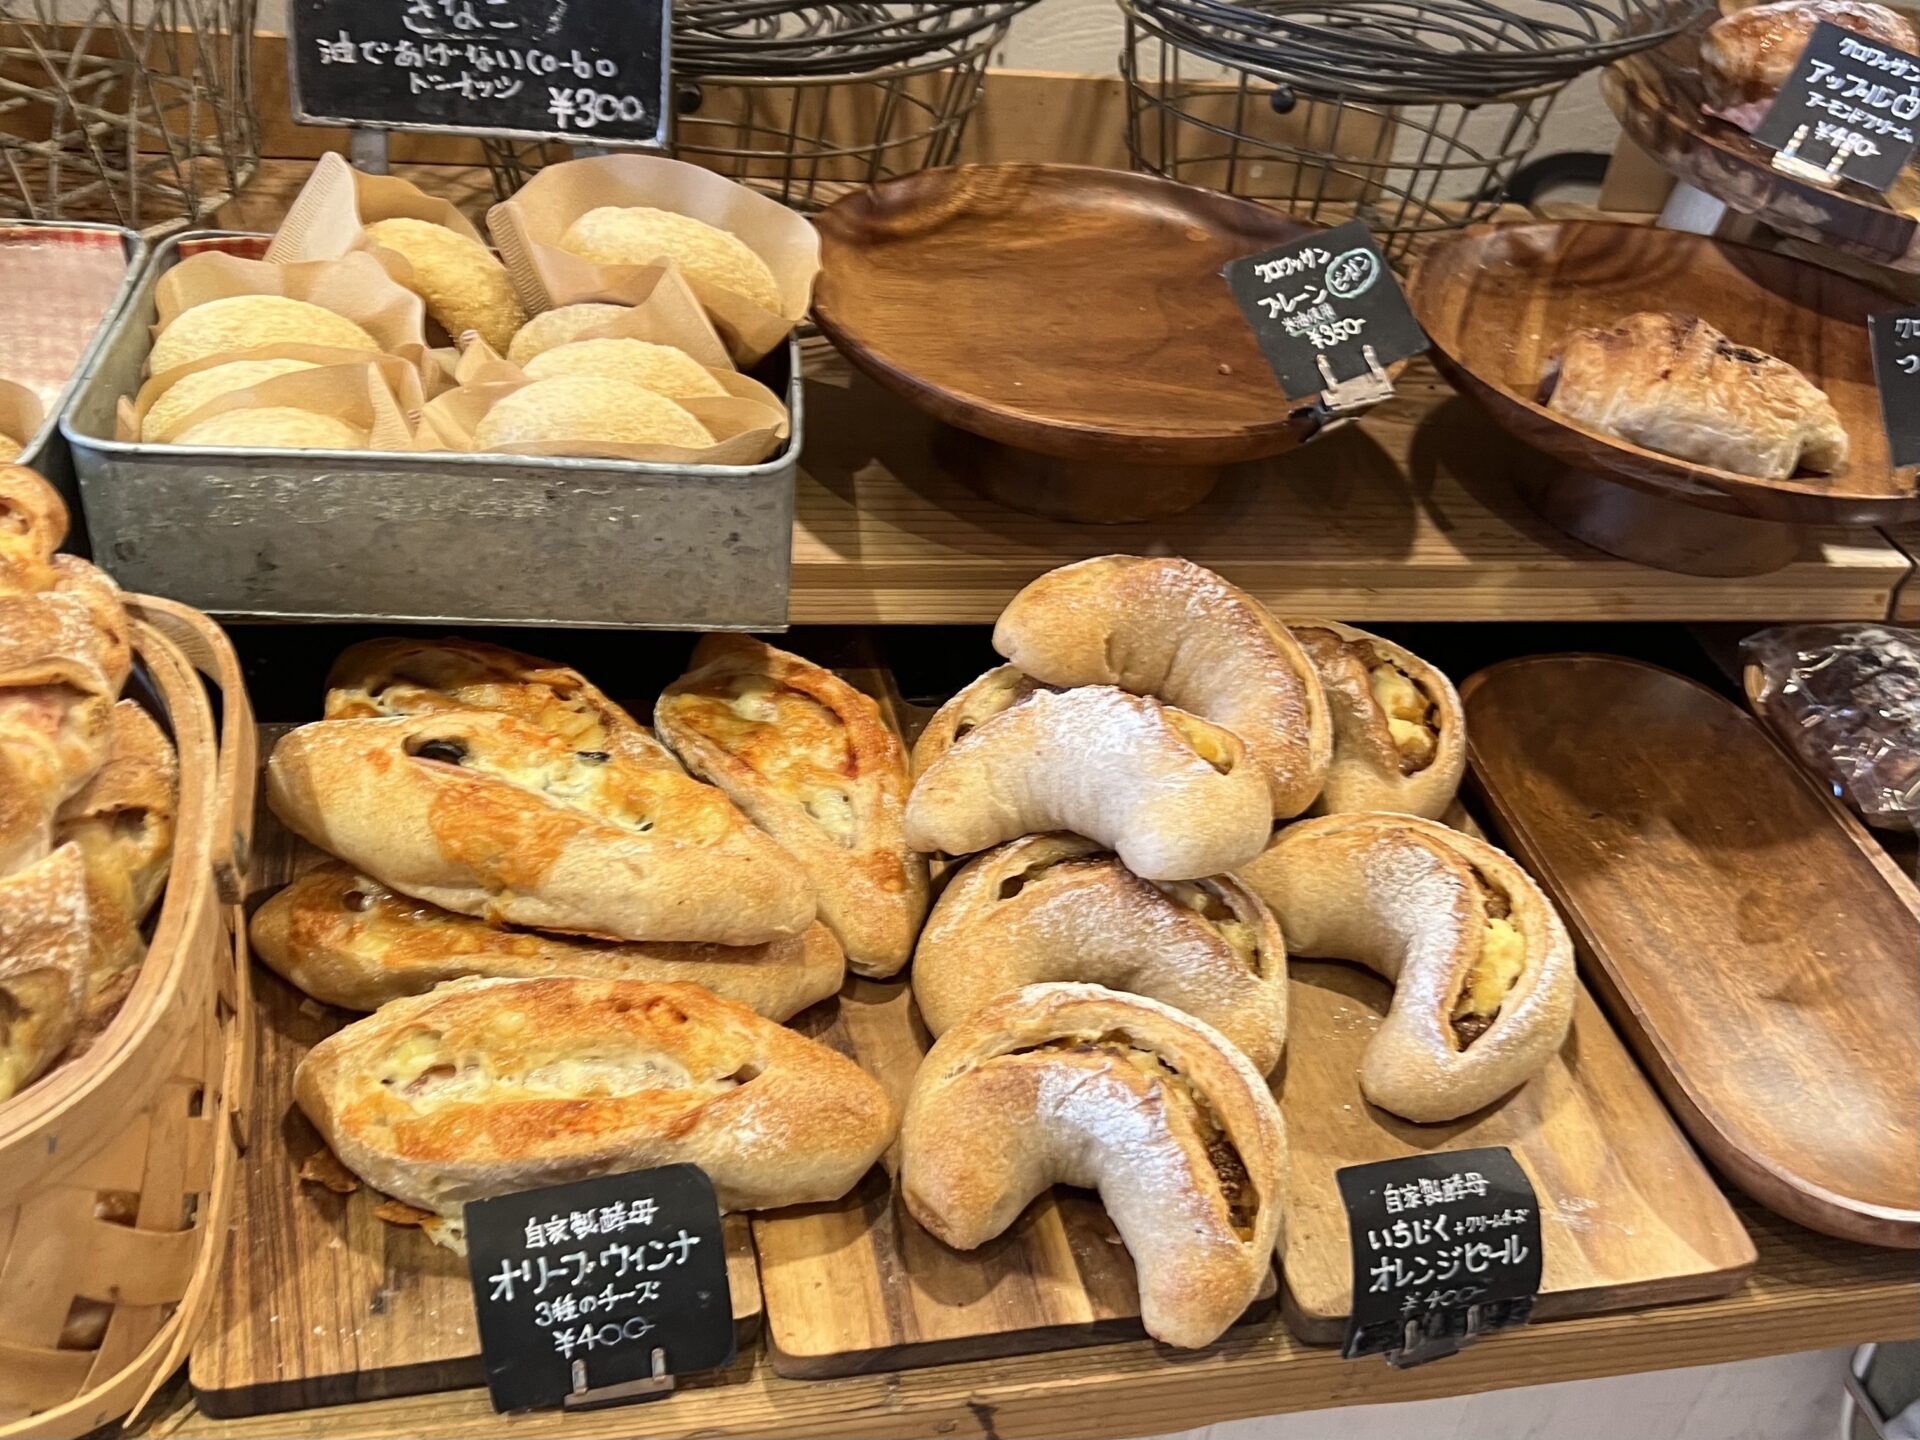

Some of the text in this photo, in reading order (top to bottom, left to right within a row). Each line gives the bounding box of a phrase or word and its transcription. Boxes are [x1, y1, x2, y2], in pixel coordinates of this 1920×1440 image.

[1805, 58, 1897, 109] アップル
[547, 86, 645, 129] ¥300
[1805, 91, 1914, 144] アーモンドクリーム
[1254, 247, 1331, 284] クロワッサン
[1257, 284, 1329, 319] プレーン
[1383, 1171, 1491, 1214] 自家製酵母
[524, 1197, 660, 1249] 自家製酵母
[1367, 1213, 1451, 1250] いちじく
[1368, 1233, 1529, 1293] オレンジピール
[534, 1280, 662, 1327] 3種のチーズ
